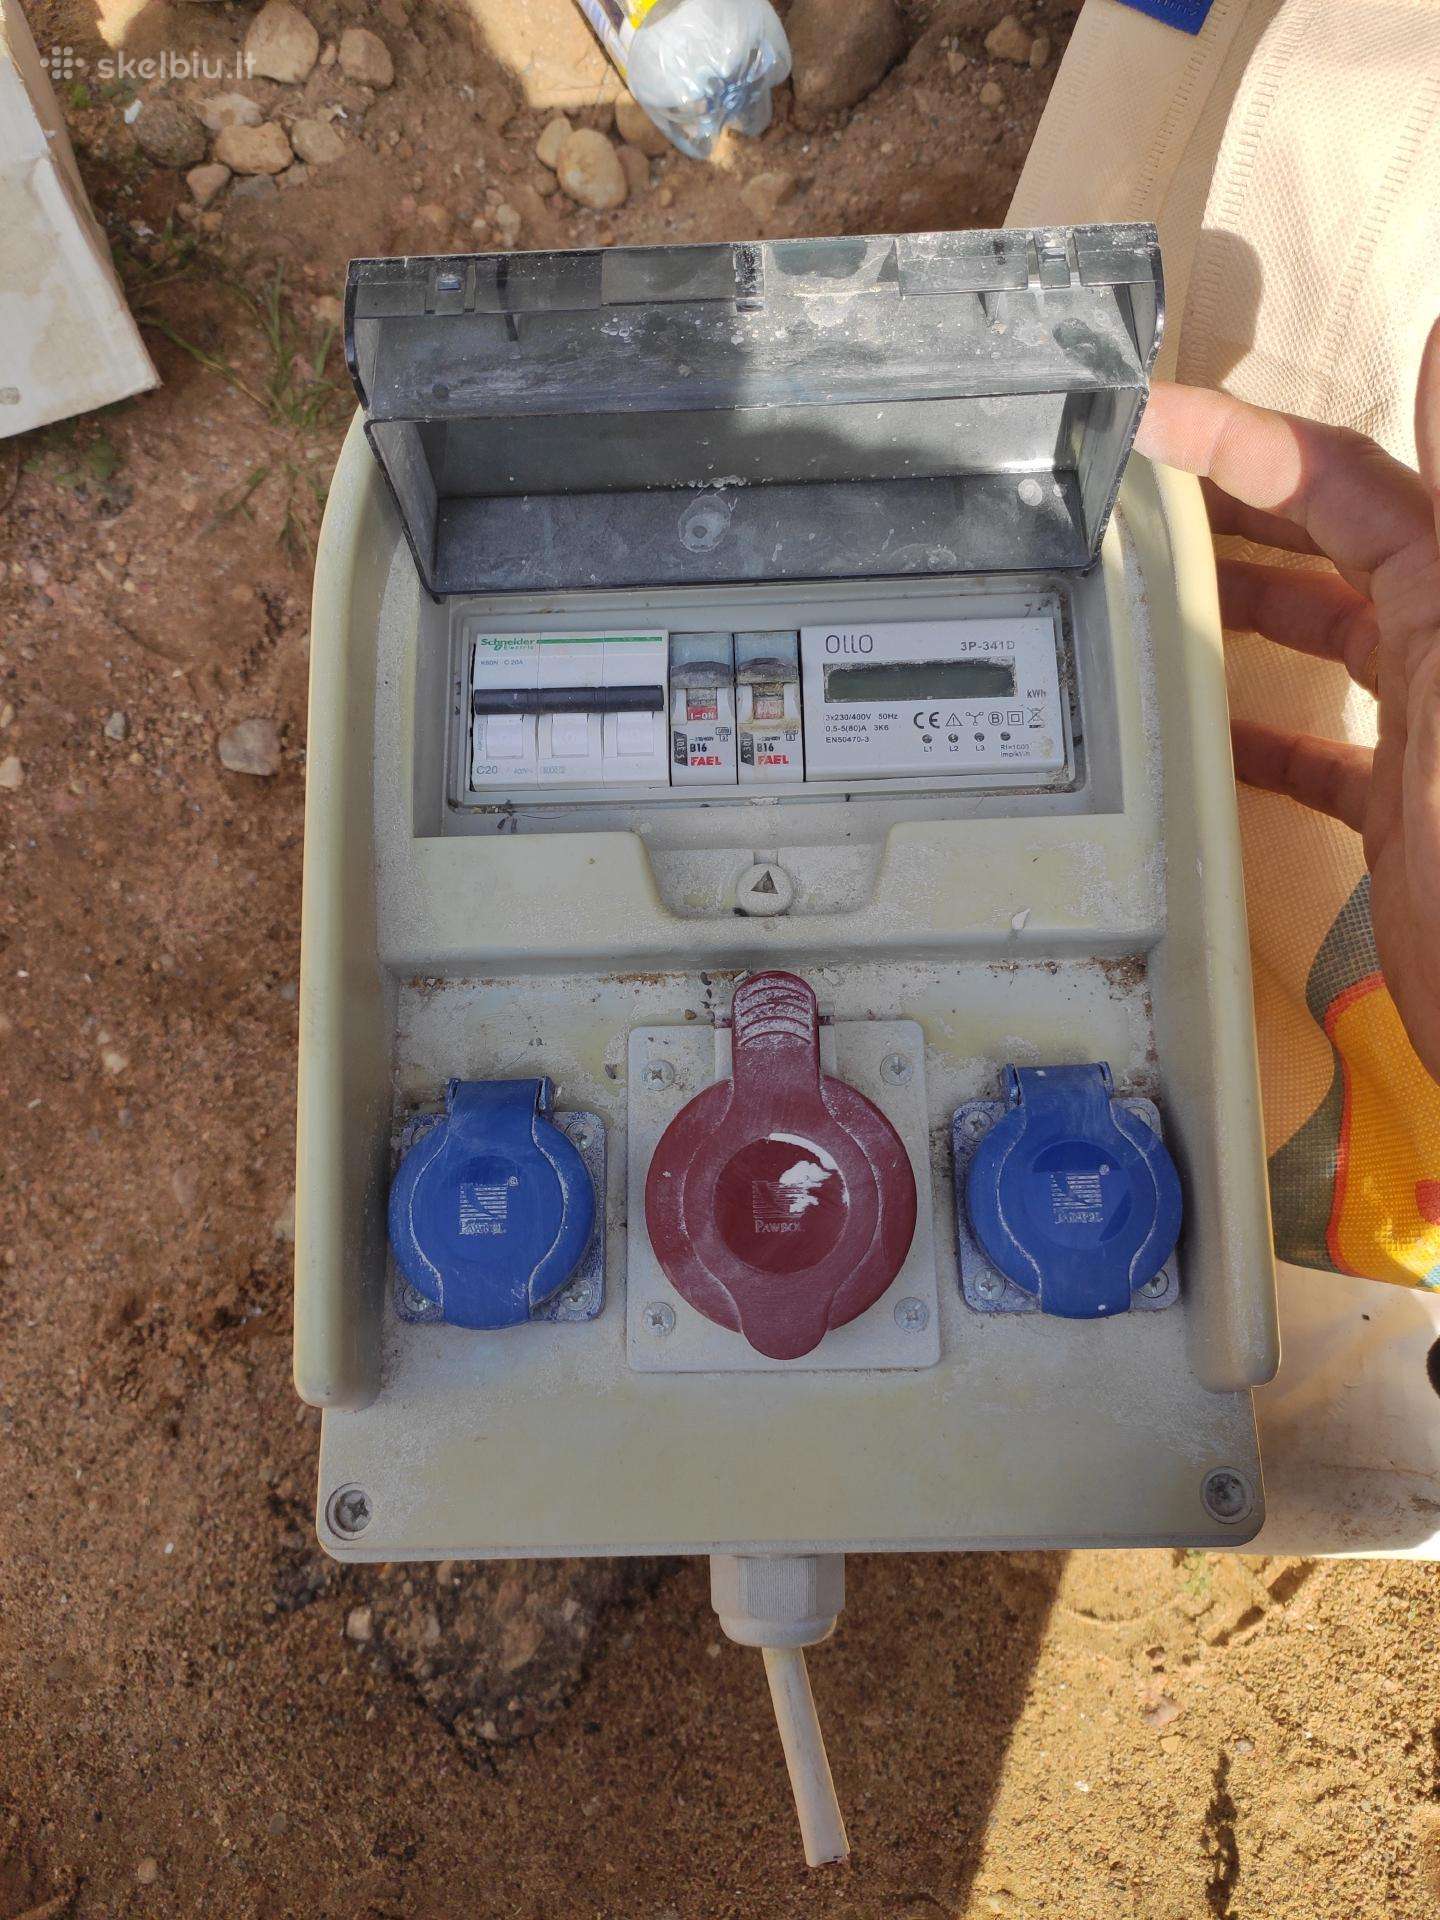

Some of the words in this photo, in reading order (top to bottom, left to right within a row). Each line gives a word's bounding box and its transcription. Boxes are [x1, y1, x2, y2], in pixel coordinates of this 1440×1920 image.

[480, 638, 536, 646] Schneider
[1026, 689, 1047, 699] kWh
[689, 743, 707, 753] B16
[756, 743, 774, 752] B16
[975, 744, 985, 752] L3
[690, 756, 722, 766] FAEL
[757, 755, 790, 765] FAEL
[476, 765, 498, 775] C20
